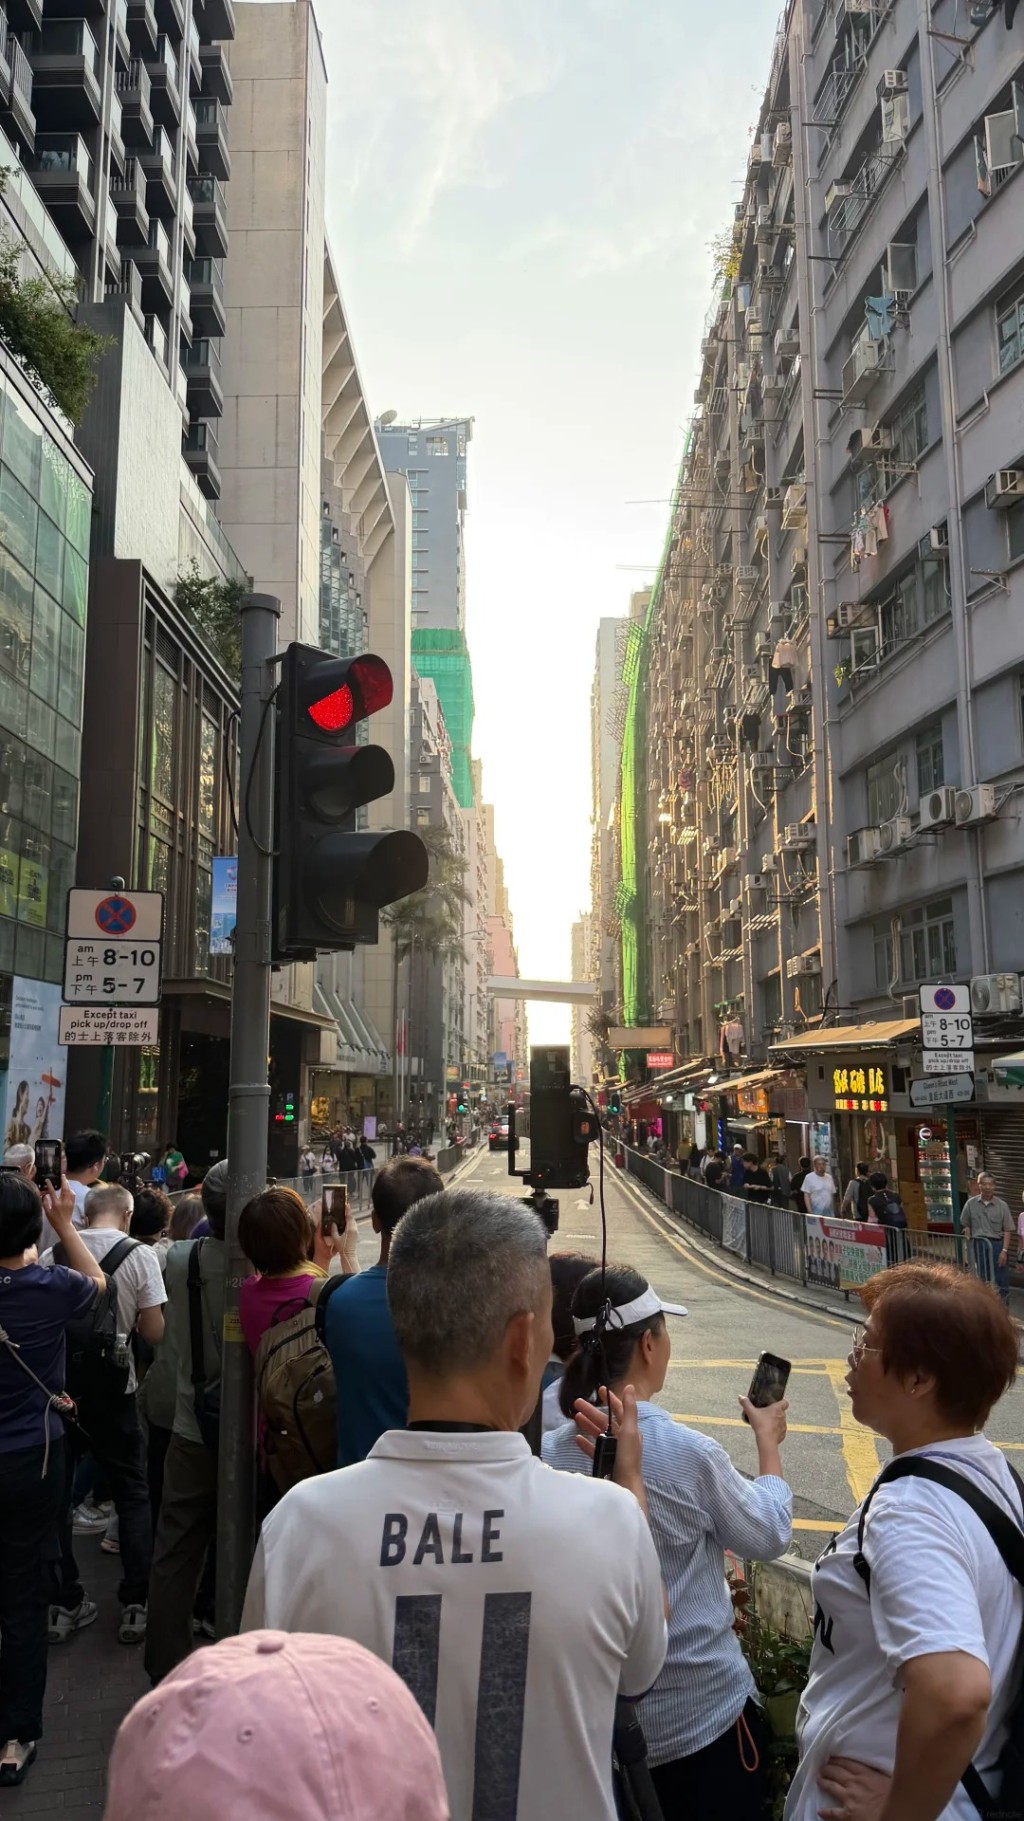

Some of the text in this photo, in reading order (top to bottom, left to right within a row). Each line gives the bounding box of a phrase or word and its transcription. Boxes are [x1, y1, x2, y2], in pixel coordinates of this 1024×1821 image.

[77, 945, 94, 953] am
[71, 948, 155, 967] 上午 8-10
[75, 974, 93, 982] pm
[70, 984, 98, 995] 下午
[83, 1010, 137, 1019] Except taxi
[70, 1020, 148, 1029] pick up/drop off
[939, 1018, 970, 1030] 8-10
[64, 1031, 152, 1041] 的士上落客除外
[940, 1034, 965, 1047] 5-7
[380, 1509, 505, 1566] BALE
